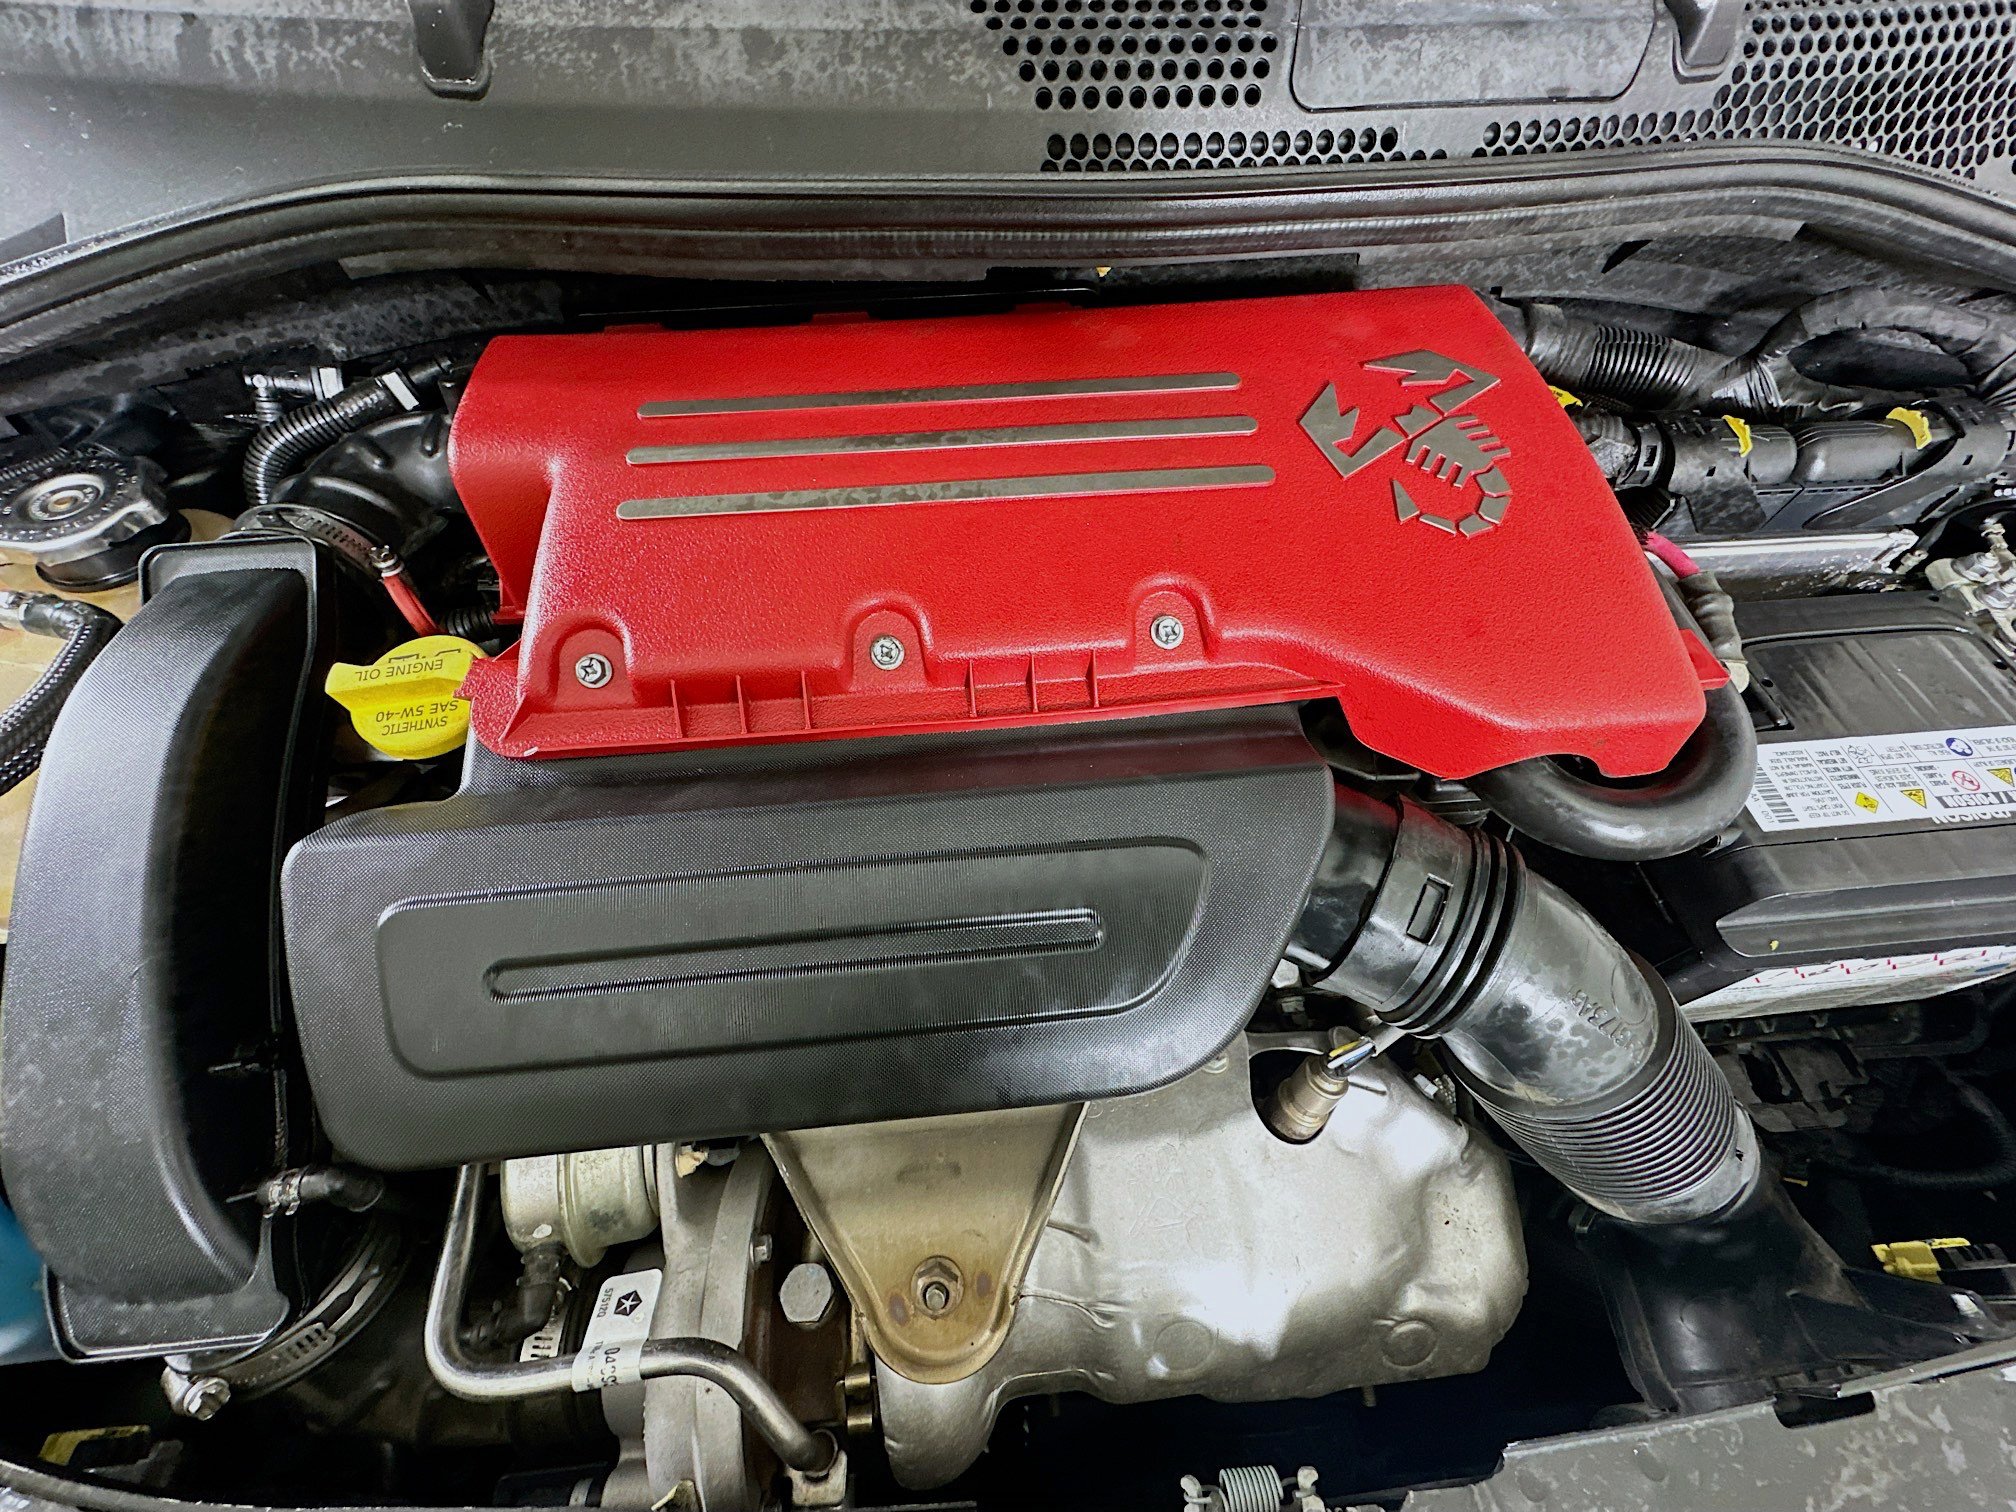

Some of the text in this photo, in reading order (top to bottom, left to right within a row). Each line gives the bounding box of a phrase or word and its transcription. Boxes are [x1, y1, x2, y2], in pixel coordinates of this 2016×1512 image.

[355, 659, 443, 681] ENGINE OIL
[376, 700, 459, 722] SAE 5W-40
[382, 716, 448, 736] SYNTHETIC
[1942, 793, 2000, 808] POISON
